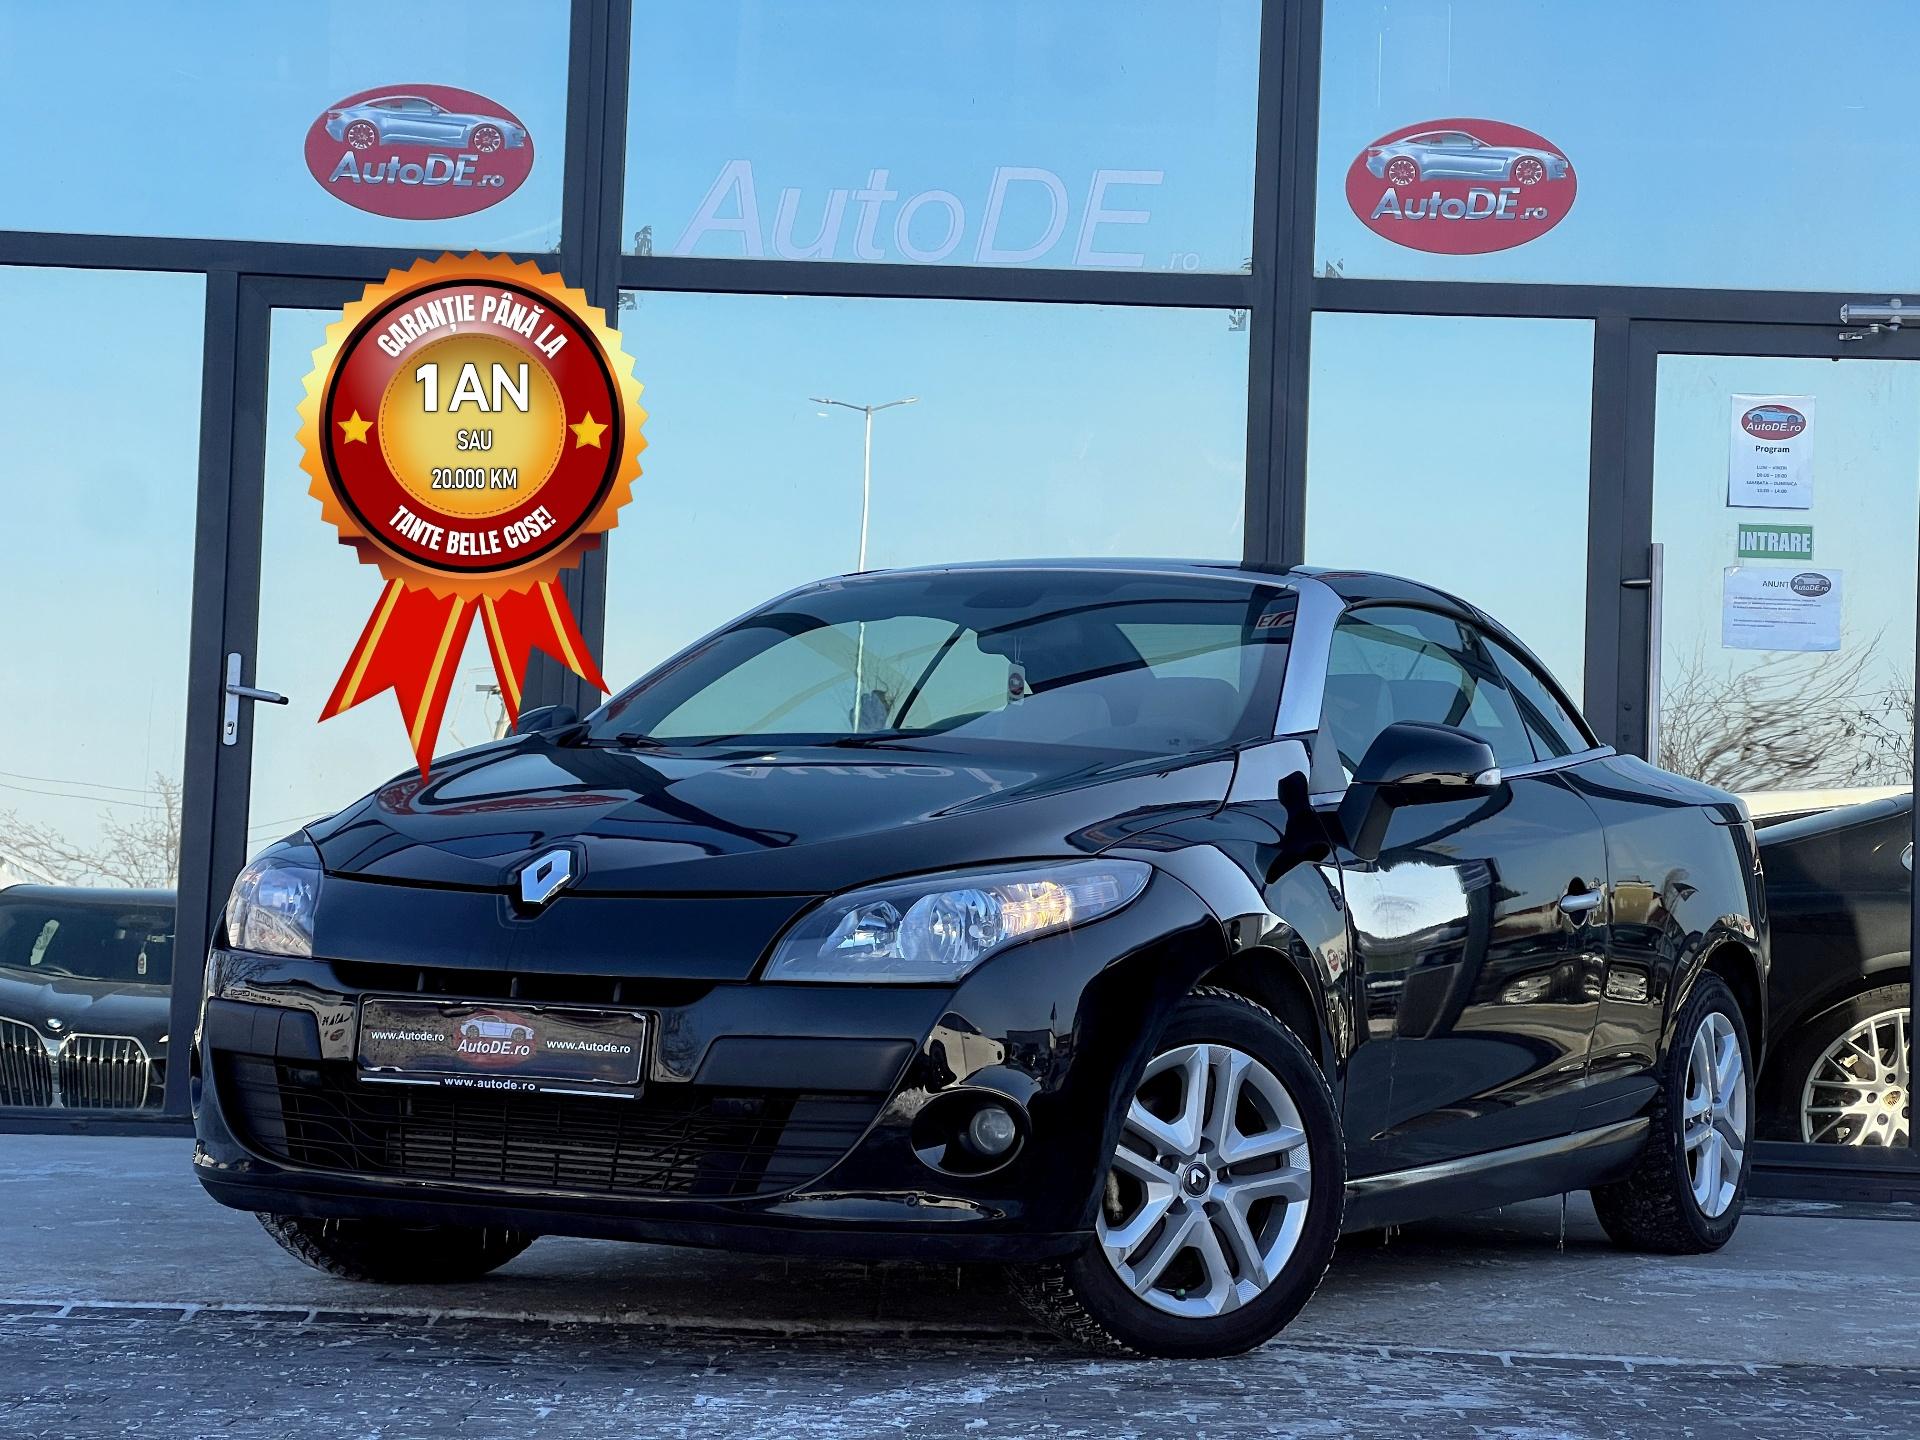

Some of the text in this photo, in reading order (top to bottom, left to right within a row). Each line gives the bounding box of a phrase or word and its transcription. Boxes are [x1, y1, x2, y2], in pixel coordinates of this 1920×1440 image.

[328, 150, 505, 187] AutoDE.ro
[1371, 187, 1548, 220] AutoDE.ro
[1746, 422, 1802, 432] AutoDE.ro
[1755, 445, 1790, 454] Program
[1740, 531, 1811, 553] INTRARE
[371, 1030, 445, 1042] www.Autode.ro
[457, 1039, 531, 1056] AutoDE.ro
[546, 1040, 631, 1054] www.Autode.ro
[444, 1076, 536, 1092] www.autode.ro
